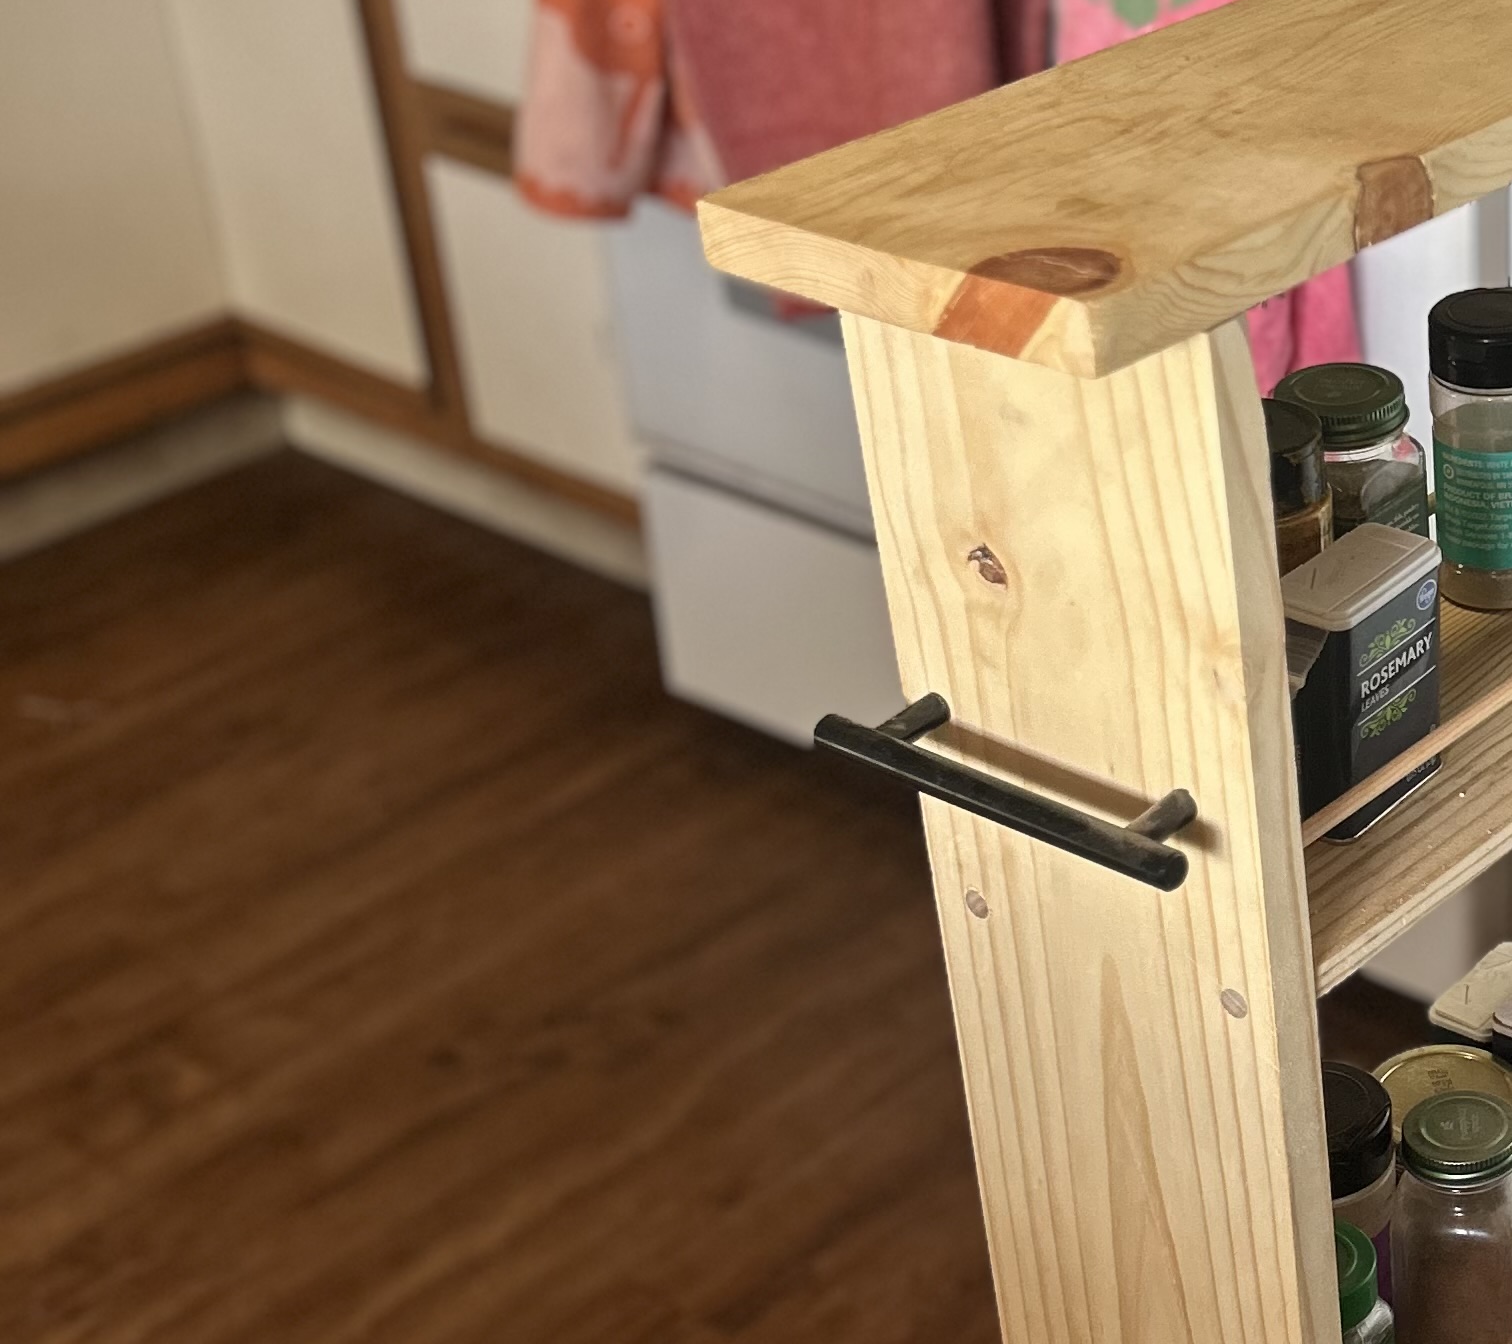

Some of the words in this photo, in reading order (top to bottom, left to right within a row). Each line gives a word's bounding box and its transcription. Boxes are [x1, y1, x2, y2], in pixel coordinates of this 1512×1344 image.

[1443, 482, 1480, 499] PRODUCT
[1483, 492, 1496, 500] OF
[1360, 631, 1433, 699] ROSEMARY
[1361, 684, 1391, 713] LEAVES
